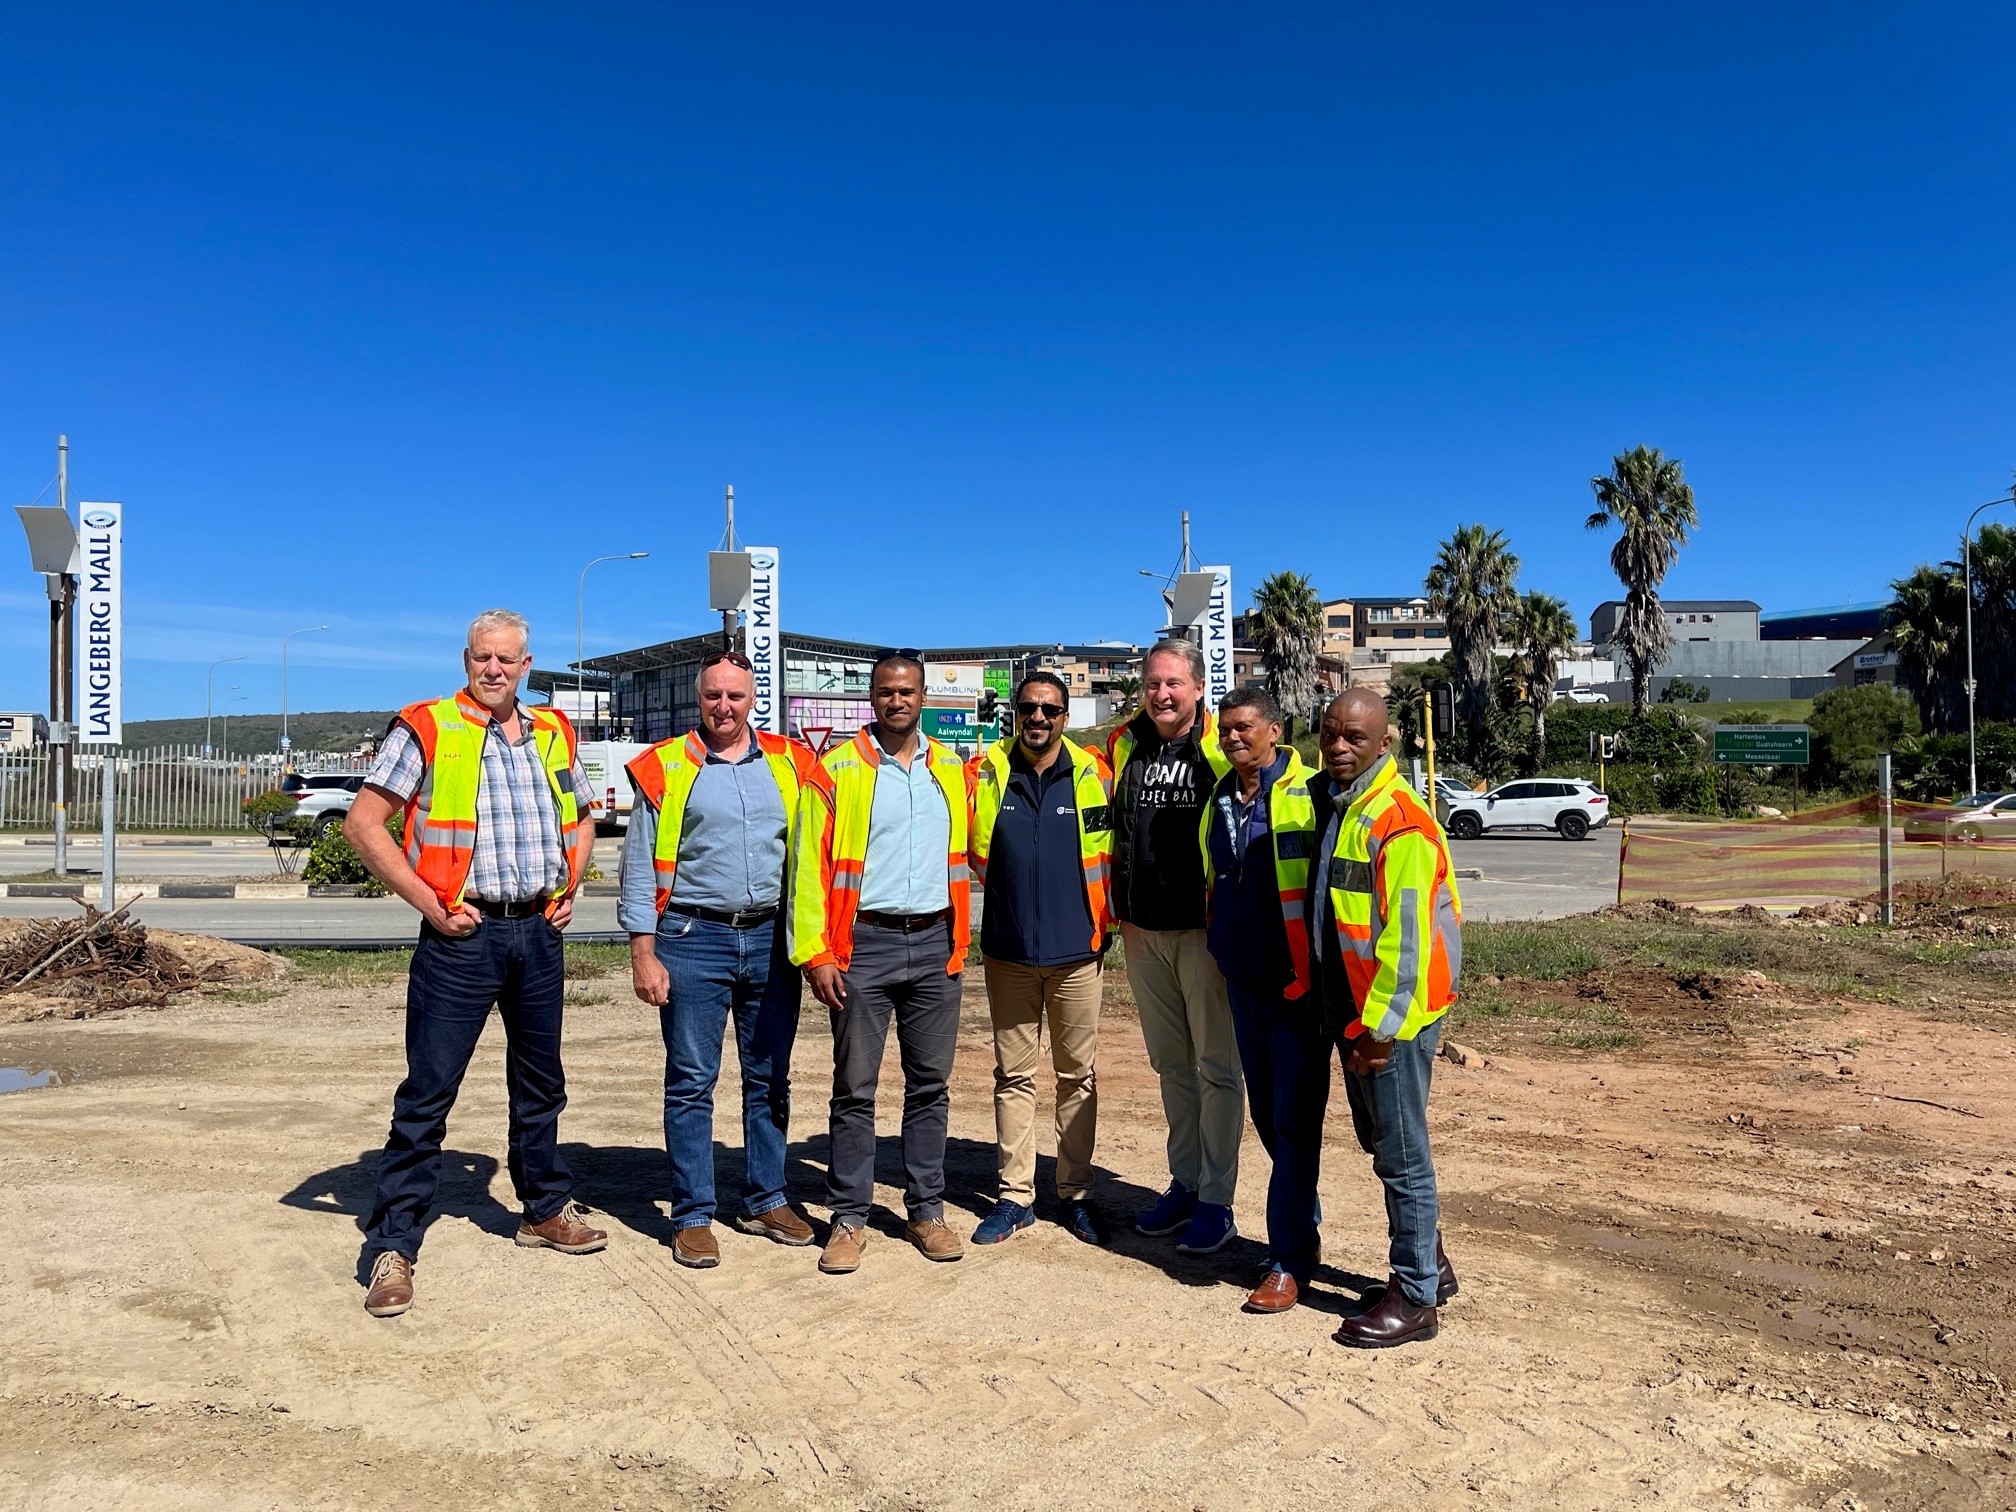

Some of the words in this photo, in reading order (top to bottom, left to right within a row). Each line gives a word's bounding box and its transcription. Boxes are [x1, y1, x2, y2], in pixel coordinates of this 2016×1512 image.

[90, 534, 111, 592] MALL
[753, 575, 771, 627] MALL
[1209, 592, 1225, 640] MALL
[90, 602, 111, 736] LANGEBERG
[754, 636, 772, 732] NGEBERG
[927, 686, 979, 694] PLUMBLINK
[1210, 648, 1227, 714] EBERG
[938, 728, 973, 737] Aalwyndal
[1173, 790, 1196, 803] BAY
